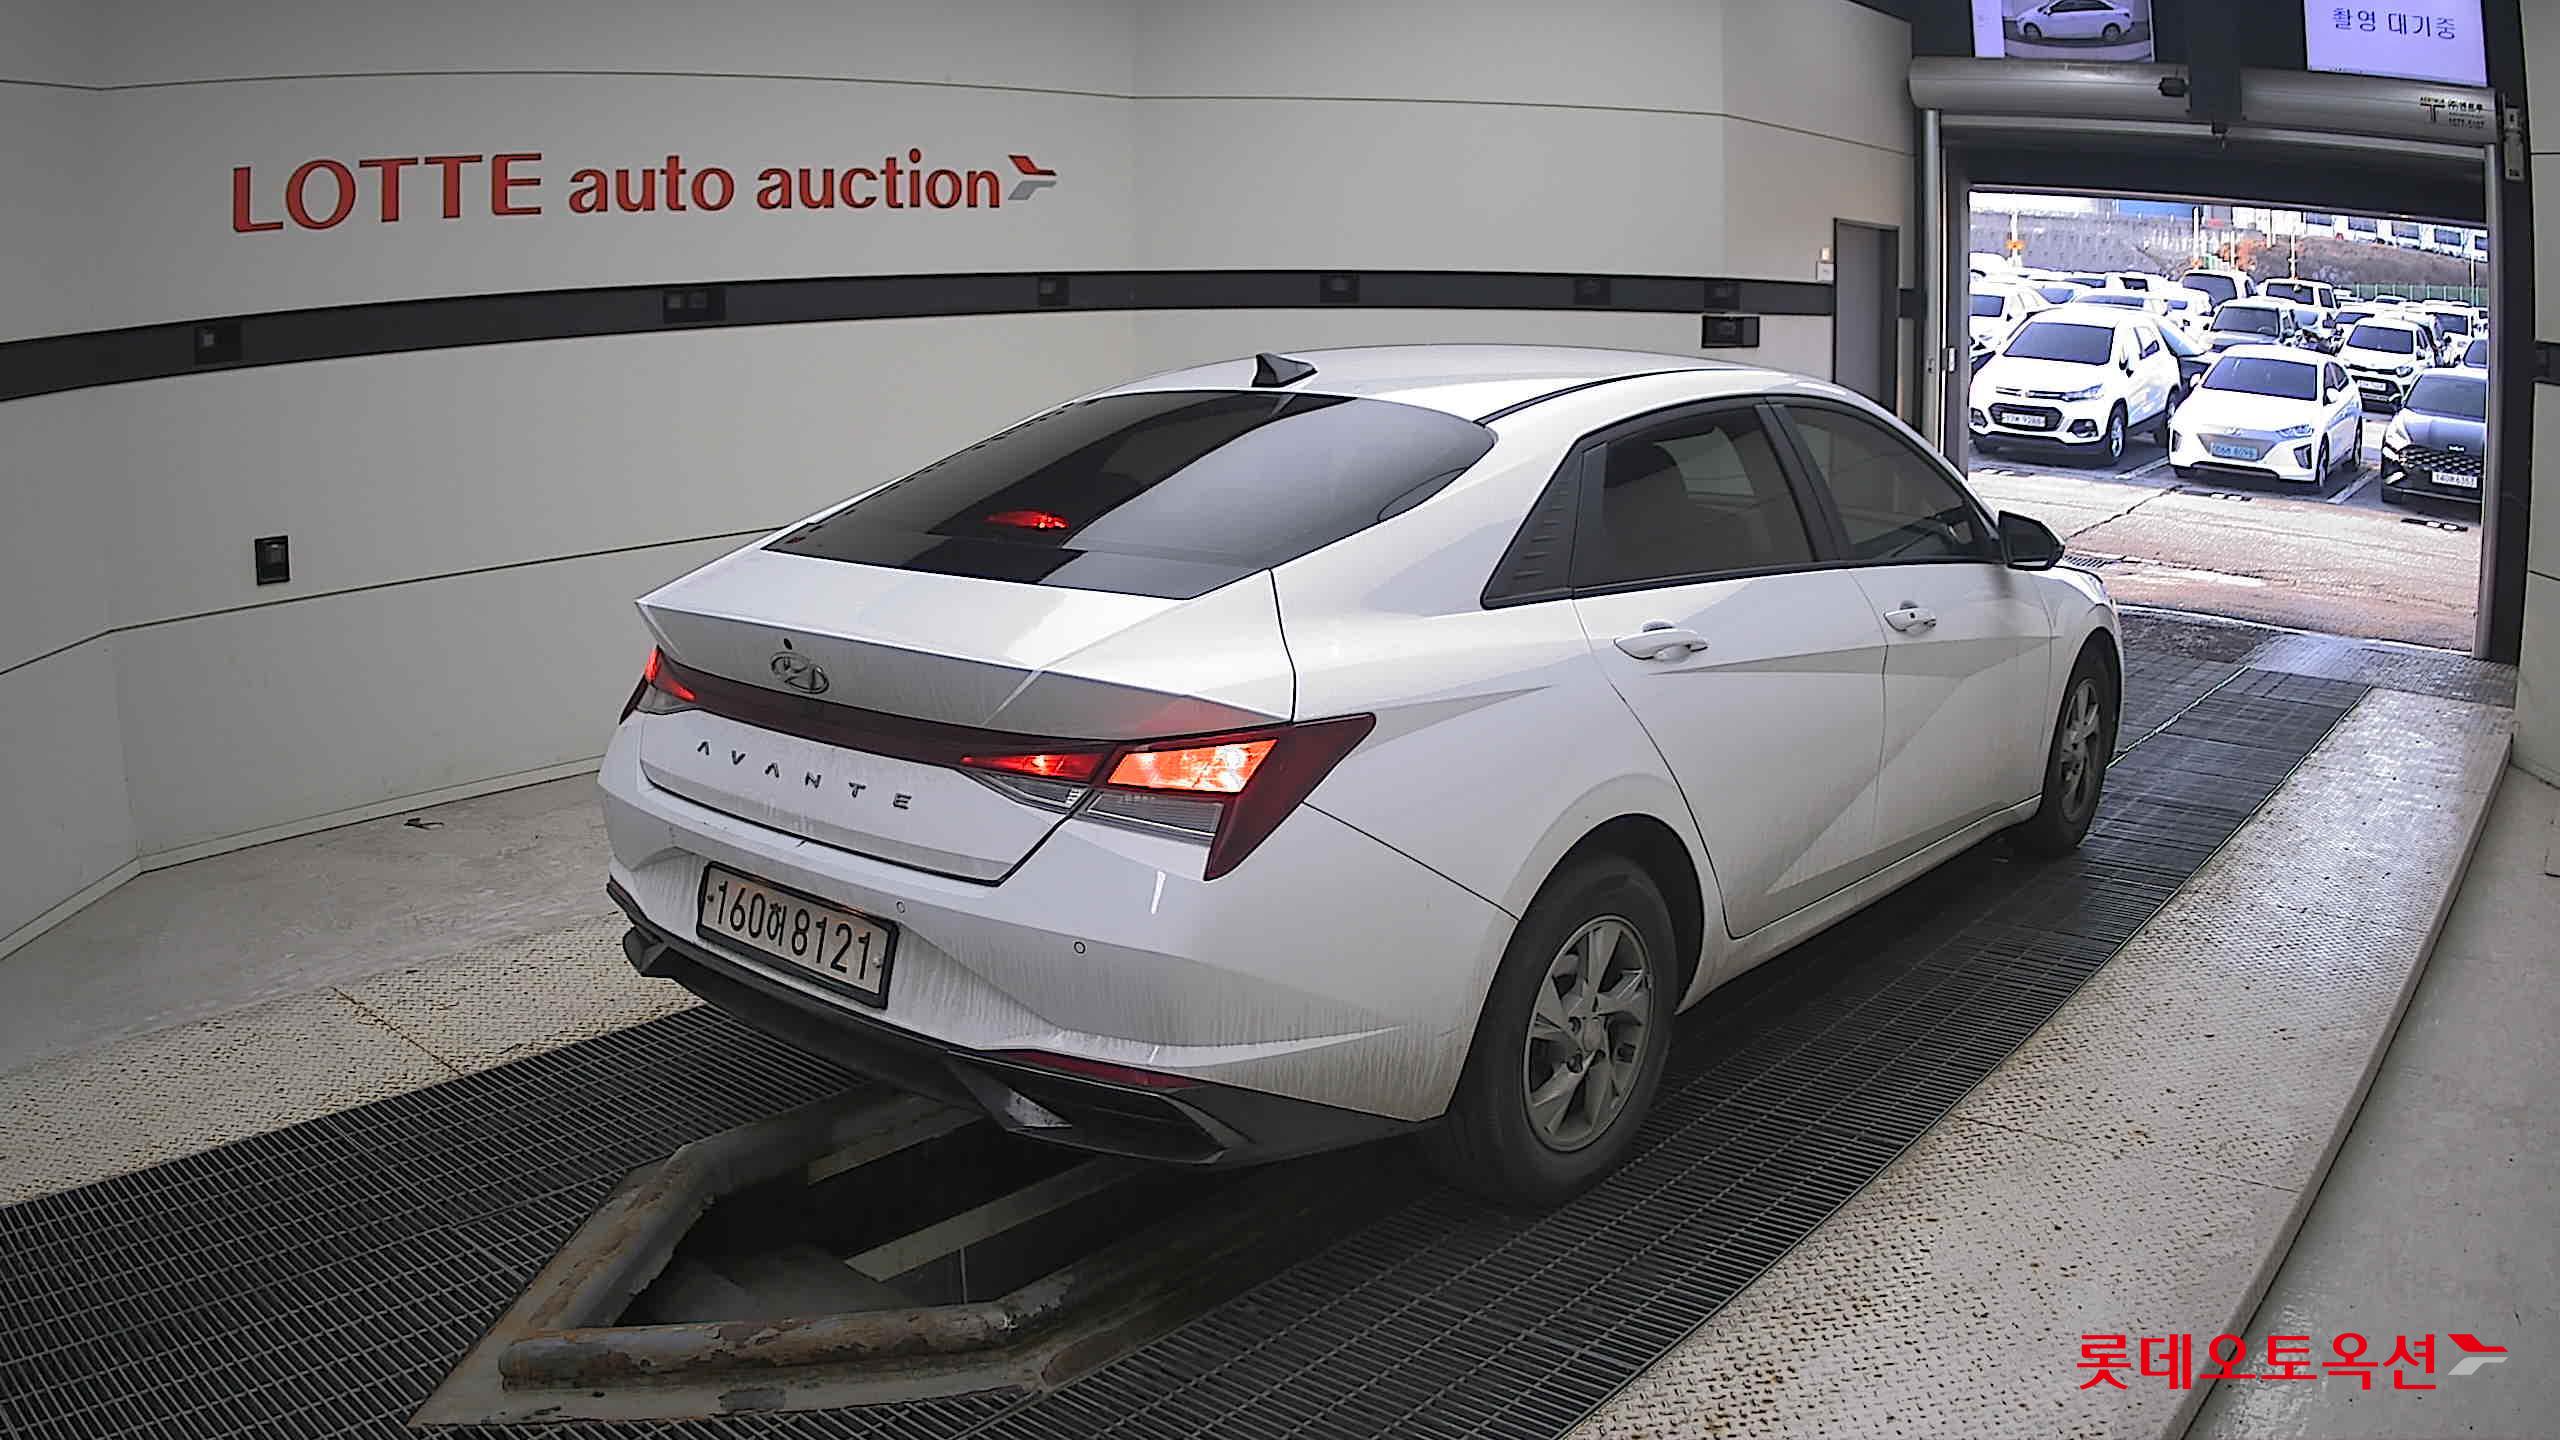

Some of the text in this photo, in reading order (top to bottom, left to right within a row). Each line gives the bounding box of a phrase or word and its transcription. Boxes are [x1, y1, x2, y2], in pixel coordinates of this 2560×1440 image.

[2334, 7, 2456, 40] 촬영 대기중
[232, 149, 1002, 233] LOTTE auto auction
[697, 741, 912, 809] AVANTE
[717, 881, 872, 980] 160허8121
